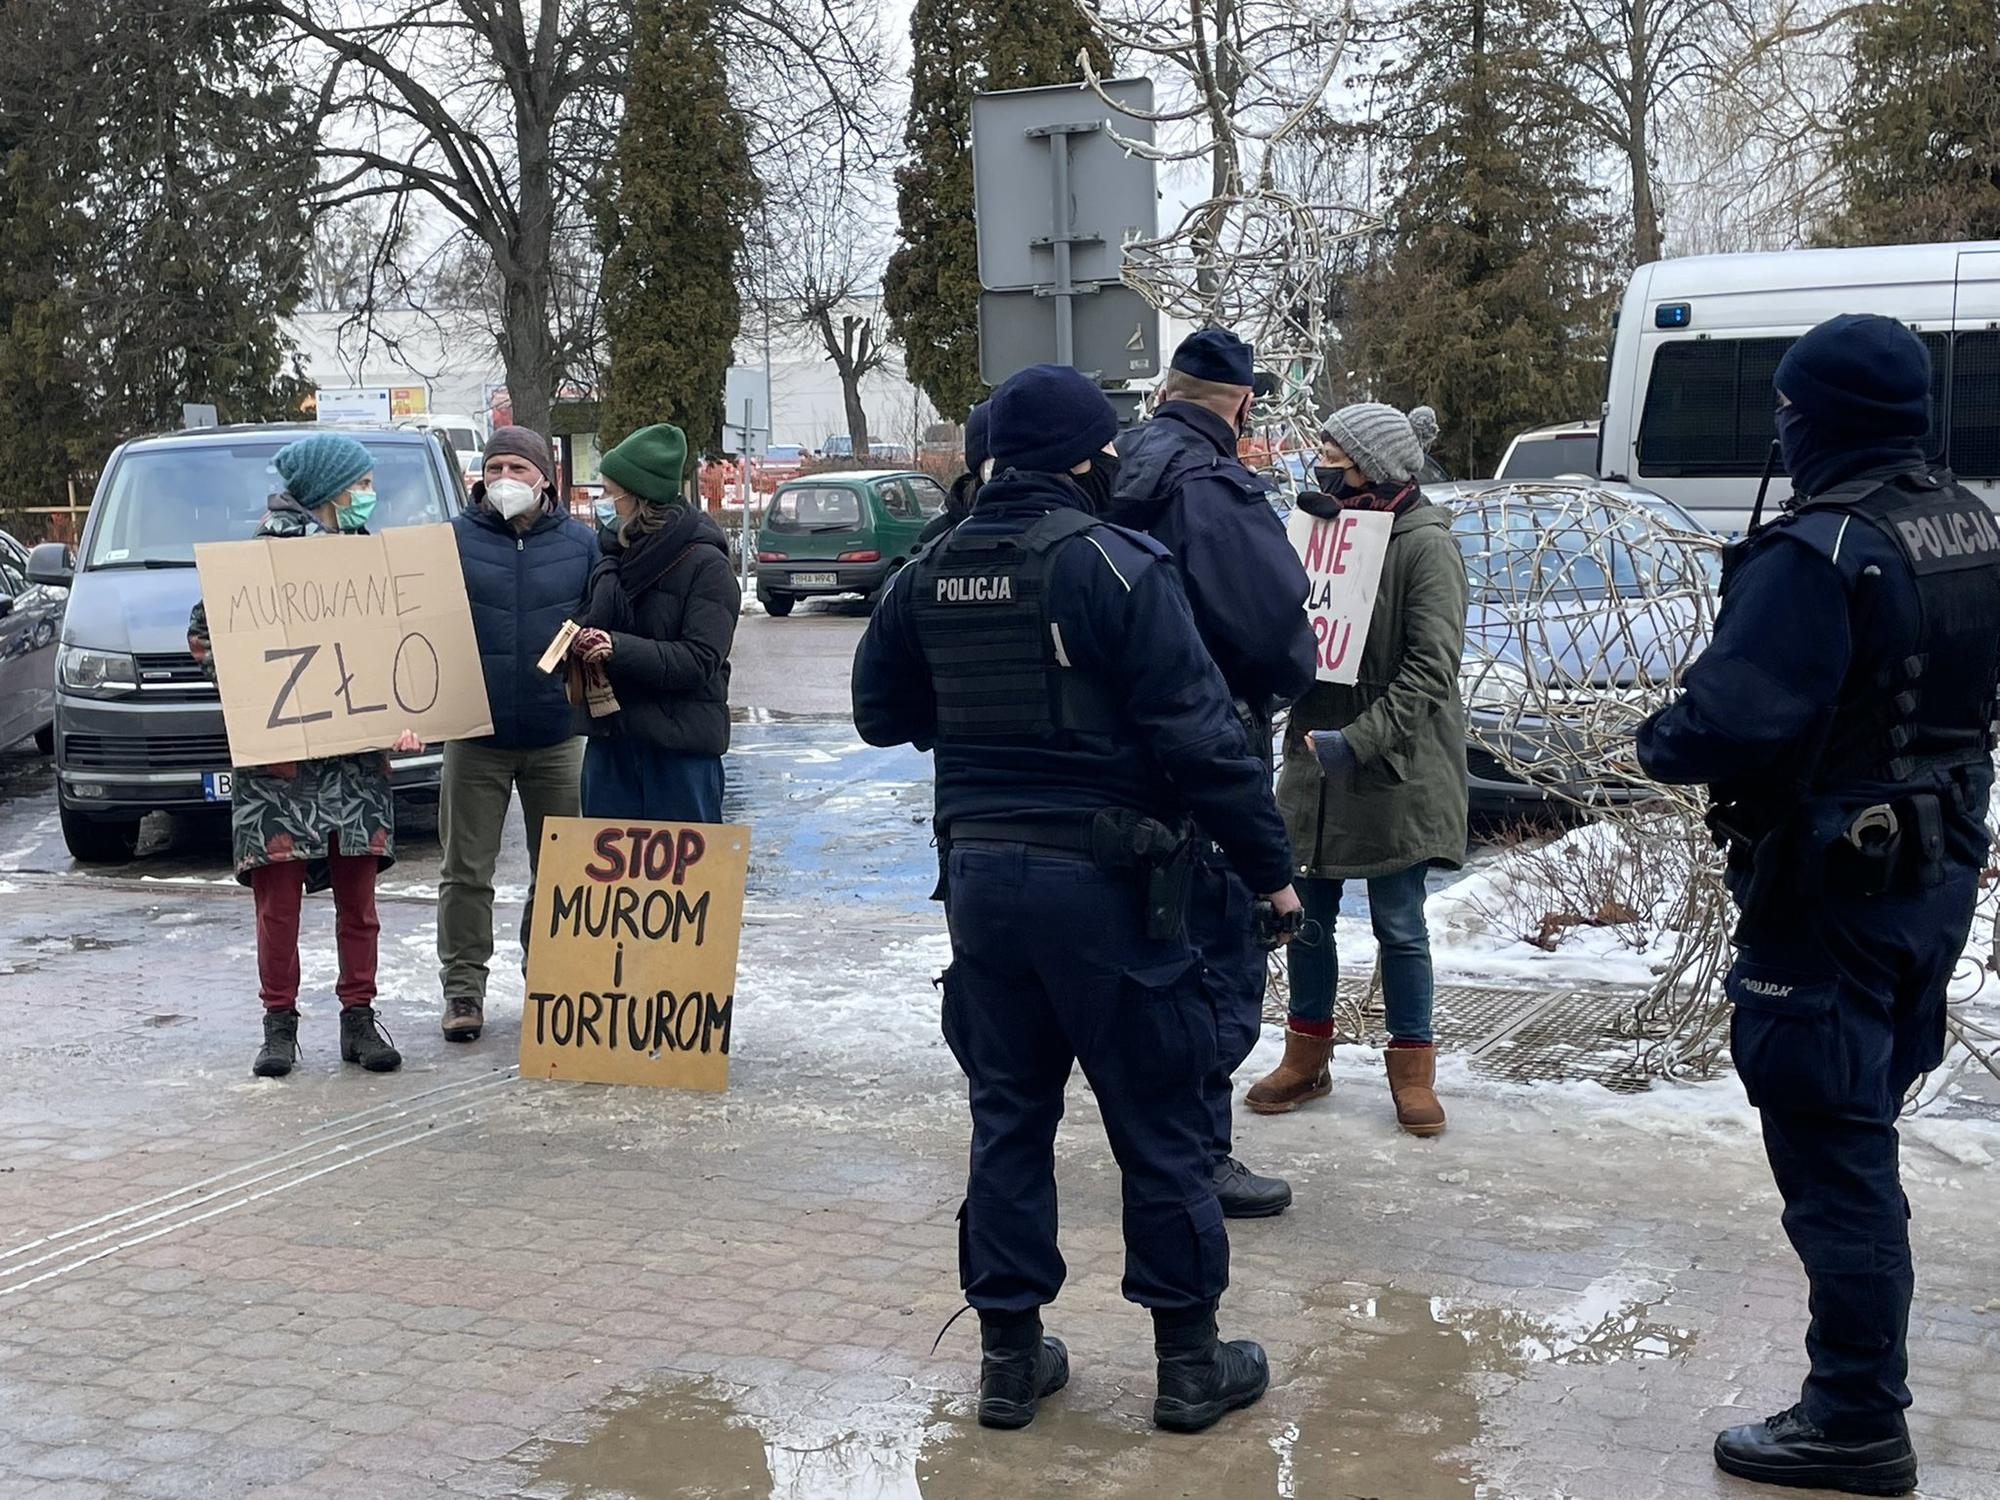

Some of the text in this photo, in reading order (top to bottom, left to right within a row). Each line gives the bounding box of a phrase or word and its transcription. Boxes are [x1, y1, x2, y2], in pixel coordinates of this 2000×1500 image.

[1304, 518, 1358, 575] NIE
[1896, 511, 2000, 561] POLICJA
[229, 573, 425, 633] MUROWANE
[937, 576, 1011, 602] POLICJA
[264, 632, 439, 729] ZŁO
[585, 827, 705, 885] STOP
[550, 885, 710, 946] MUROM
[613, 941, 624, 988] i
[528, 990, 734, 1055] TORTUROM
